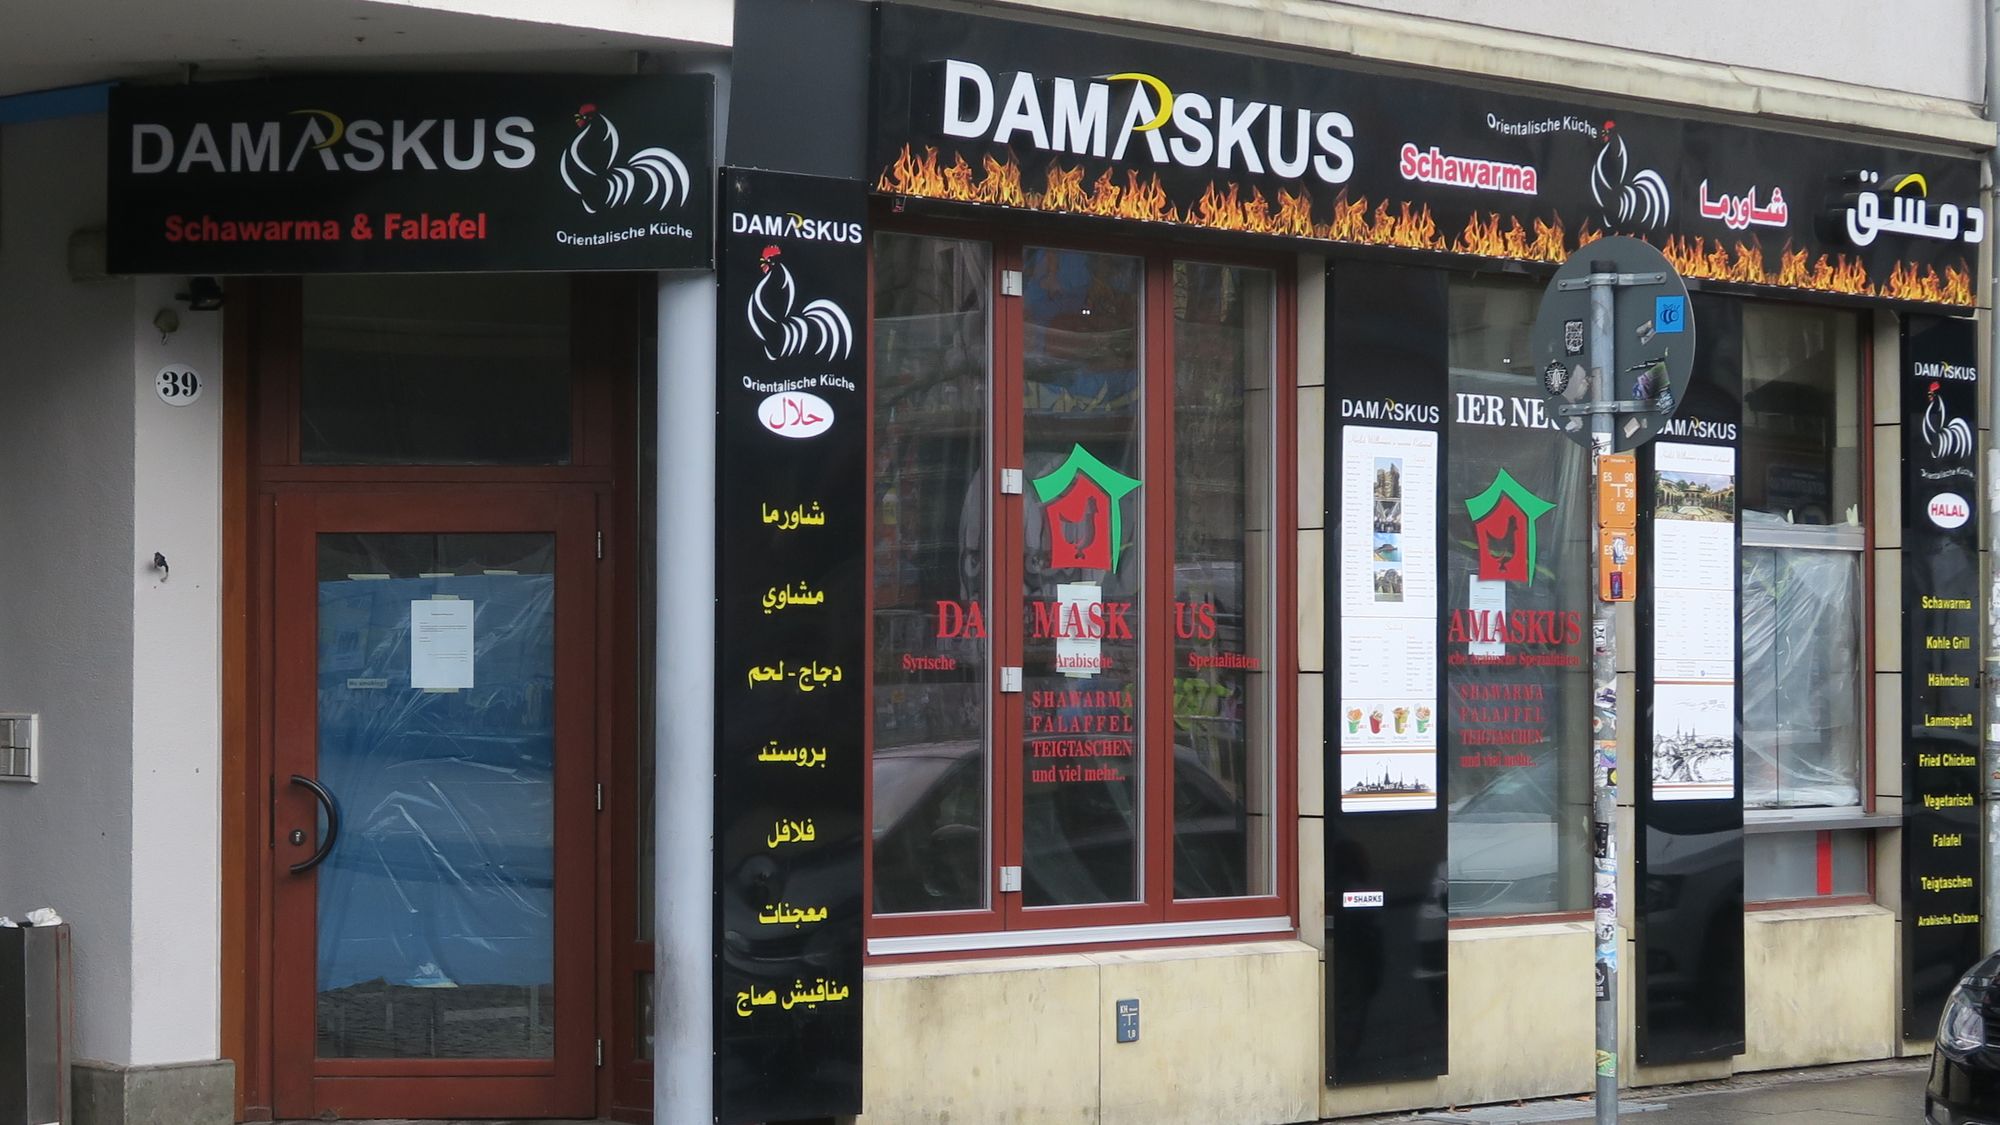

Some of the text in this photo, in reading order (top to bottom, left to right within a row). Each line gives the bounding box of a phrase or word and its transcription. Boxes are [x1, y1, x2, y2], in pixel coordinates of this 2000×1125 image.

[942, 59, 1355, 184] DAMASKUS
[1486, 113, 1598, 138] Orientalische Küche
[131, 108, 536, 174] DAMASKUS
[1400, 142, 1538, 195] Schawarma
[1700, 179, 1789, 229] شاورما
[1845, 169, 1985, 247] دمشق
[165, 212, 487, 244] Schawarma & Falafel
[556, 222, 693, 246] Orientalische Küche
[732, 212, 863, 244] DAMASKUS
[1915, 360, 1977, 381] DAMASKUS
[162, 371, 198, 397] 39
[742, 373, 856, 393] Orientalische Küche
[769, 396, 824, 430] حلال
[1341, 398, 1440, 424] DAMASKUS
[762, 501, 825, 529] شاورما
[1930, 503, 1965, 518] HALAL
[762, 580, 824, 615] مشاوي
[1921, 595, 1972, 610] Schawarma
[936, 600, 1217, 640] DA MASK US
[1926, 635, 1970, 650] Kohle Grill
[903, 651, 1262, 672] Syrische Arabische Spezialitäten
[1928, 672, 1970, 687] Hähnchen
[1031, 690, 1134, 708] SHAWARMA
[1031, 715, 1133, 733] FALAFFEL
[1925, 713, 1973, 730] Lammspieß
[758, 740, 827, 769] بروستد
[1031, 740, 1133, 758] TEIGTASCHEN
[1919, 753, 1976, 767] Fried Chicken
[1031, 765, 1057, 783] und
[1059, 764, 1082, 782] viel
[1923, 793, 1974, 811] Vegetarisch
[767, 818, 816, 849] فلافل
[1932, 833, 1962, 848] Falafel
[1920, 875, 1973, 893] Teigtaschen
[1353, 895, 1382, 903] SHARKS
[758, 902, 828, 929] معجنات
[1918, 914, 1952, 927] Arabische
[736, 978, 849, 1017] مناقيش صاج
